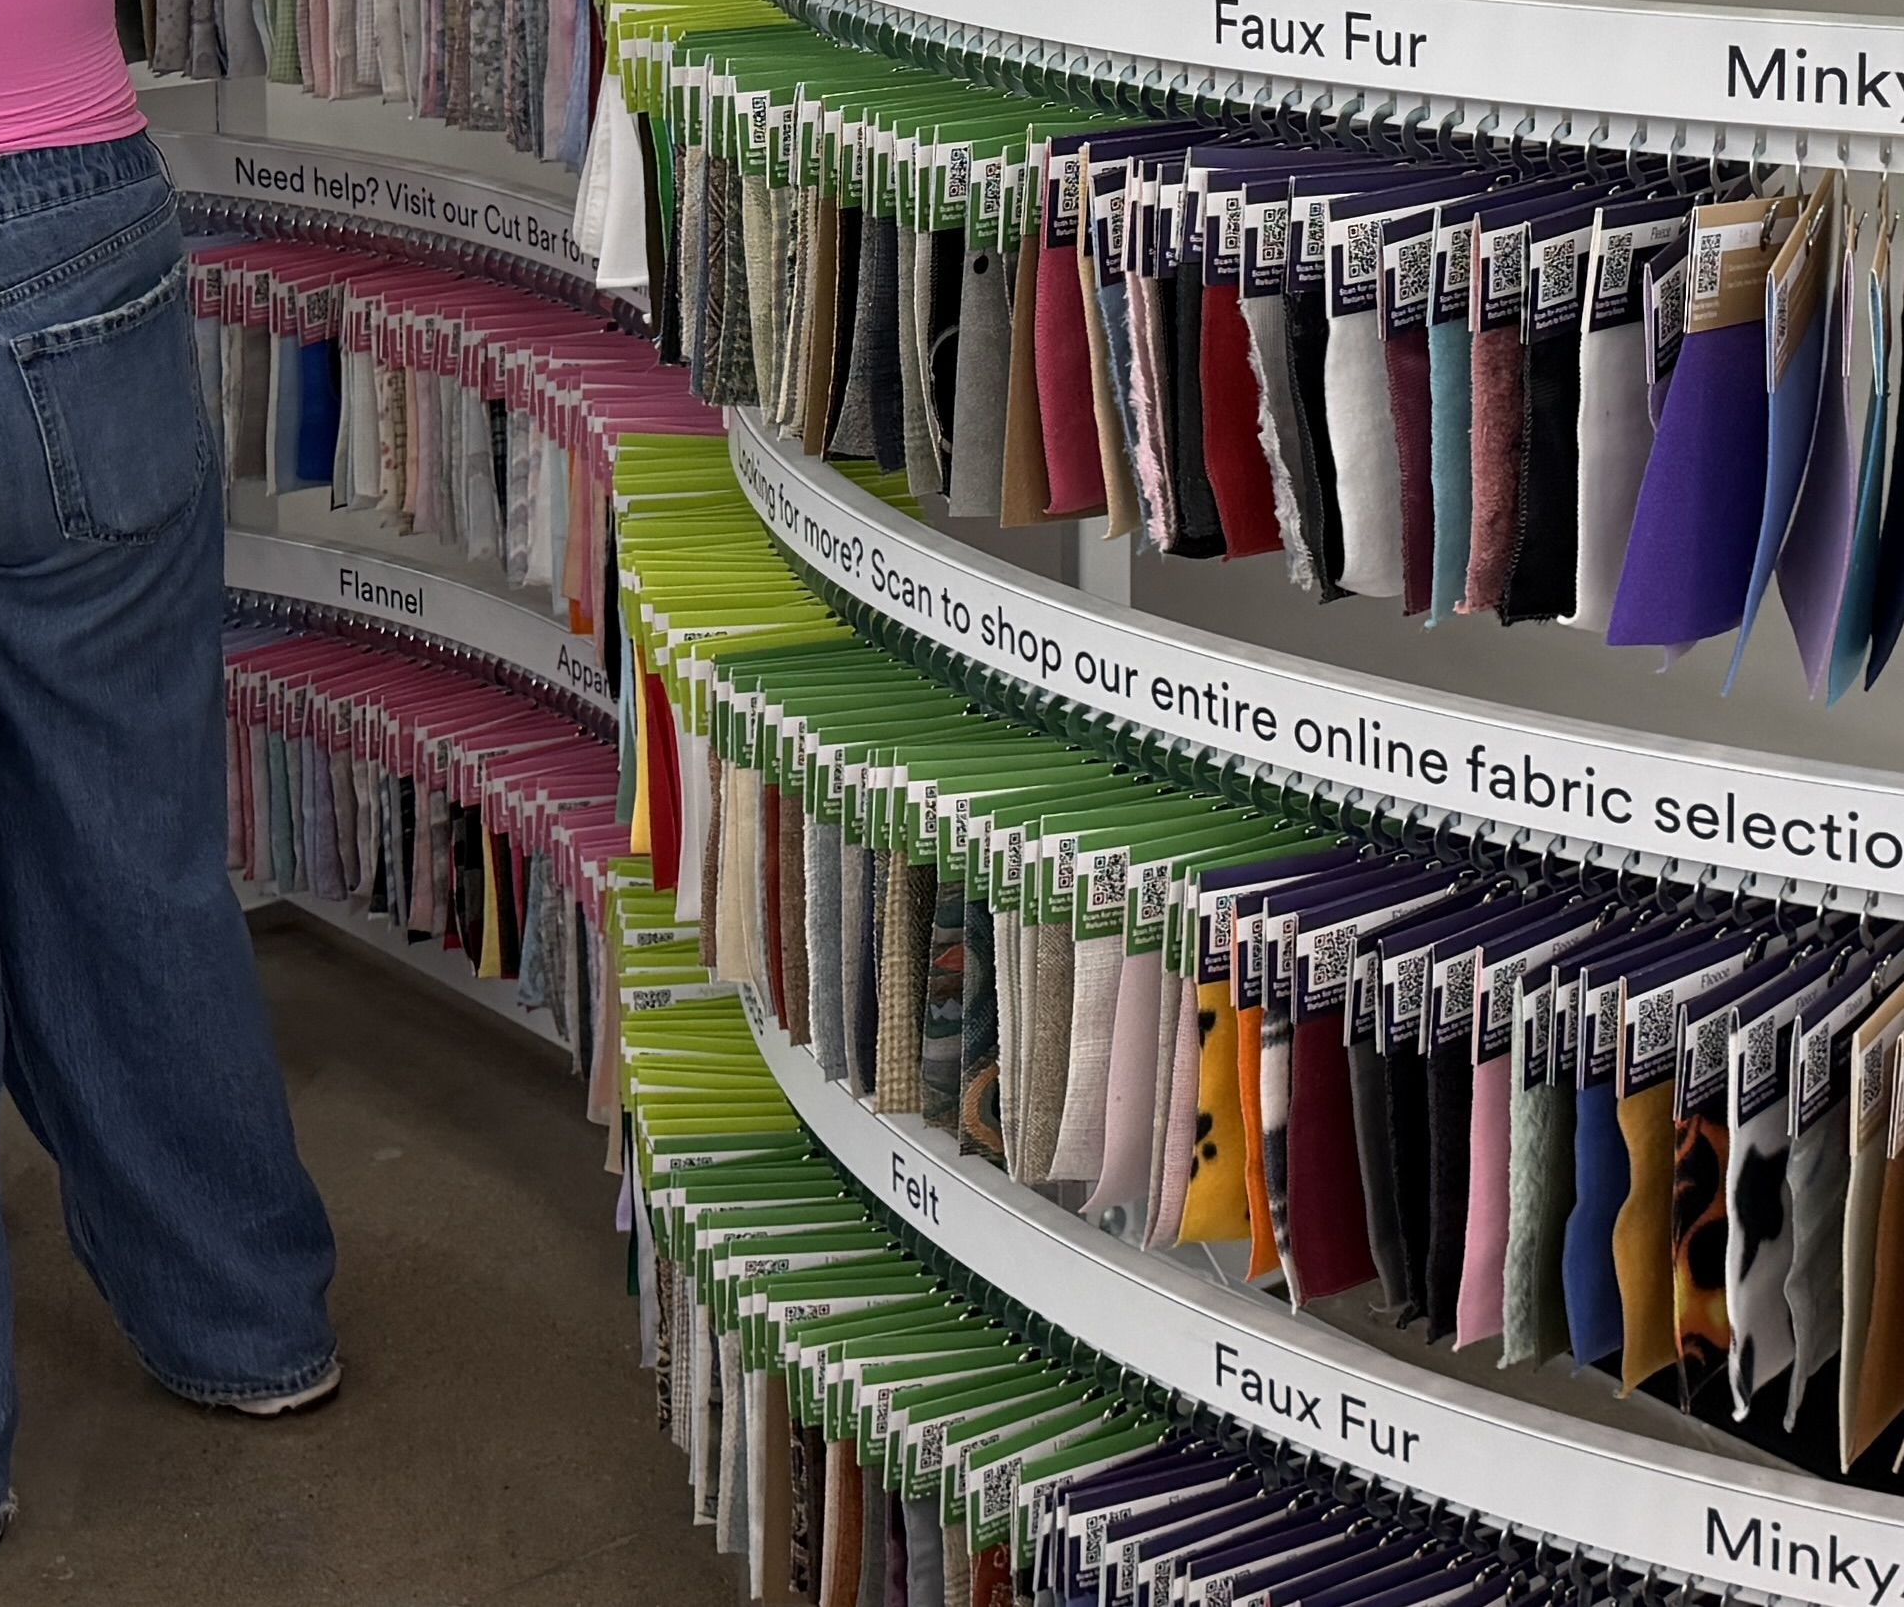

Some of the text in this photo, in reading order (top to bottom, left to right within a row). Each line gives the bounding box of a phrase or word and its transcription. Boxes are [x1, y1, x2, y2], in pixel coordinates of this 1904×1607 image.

[1345, 11, 1427, 68] Fur
[235, 156, 558, 254] Need help? Visit our Cut Bar
[338, 567, 425, 618] Flannel
[736, 444, 776, 522] Looking
[778, 482, 800, 534] for
[804, 514, 864, 579] more?
[871, 548, 933, 618] Scan
[940, 587, 971, 635] to
[981, 609, 1062, 677] shop
[1074, 651, 1139, 699] our
[1150, 676, 1277, 742] entire
[1294, 718, 1448, 785] online
[1465, 744, 1633, 824] fabric
[888, 1148, 943, 1228] Felt
[1215, 1341, 1420, 1463] Faux Fur
